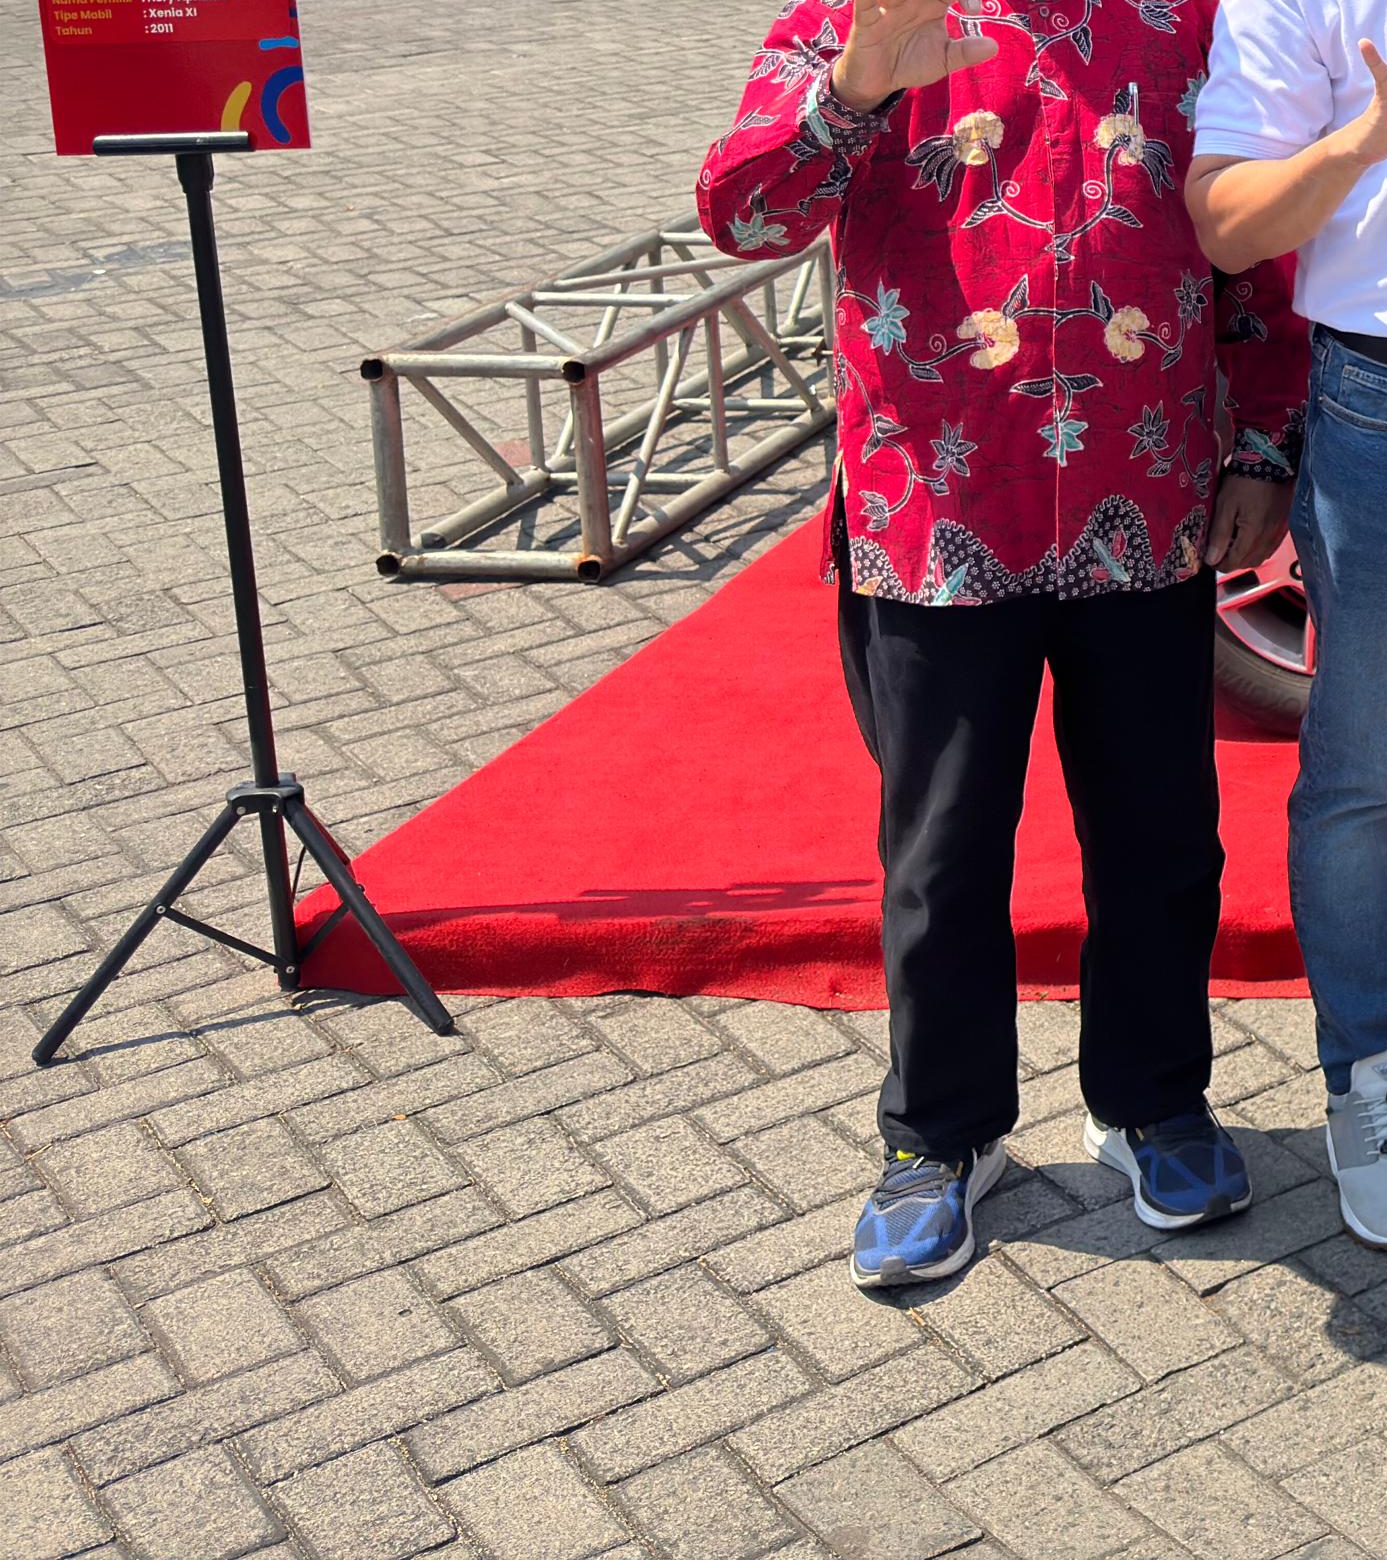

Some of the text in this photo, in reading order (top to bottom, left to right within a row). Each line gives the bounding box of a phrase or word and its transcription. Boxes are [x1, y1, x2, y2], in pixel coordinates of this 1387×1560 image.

[54, 10, 78, 22] Tipe
[80, 9, 112, 20] Mobil
[149, 7, 183, 18] Xenia
[56, 25, 92, 36] Tahun
[150, 23, 174, 33] 2011
